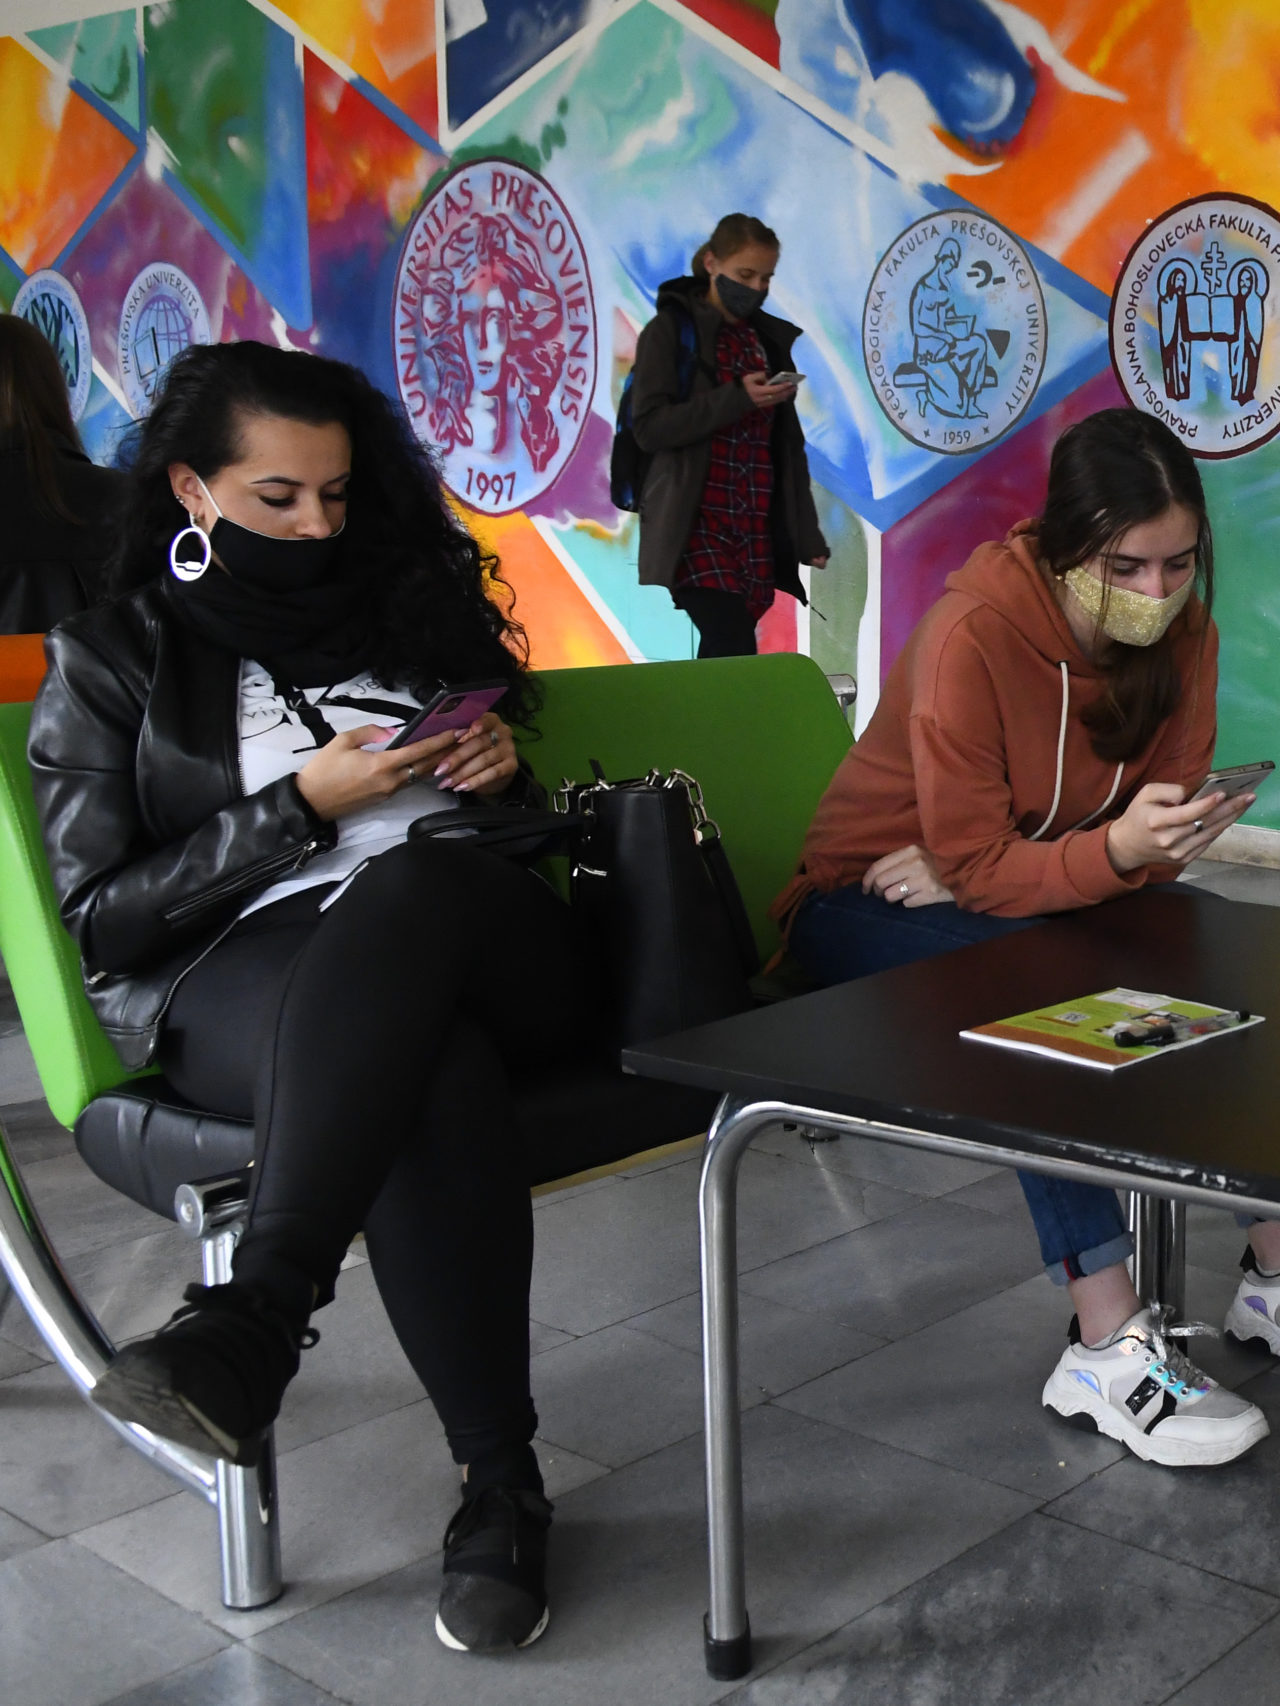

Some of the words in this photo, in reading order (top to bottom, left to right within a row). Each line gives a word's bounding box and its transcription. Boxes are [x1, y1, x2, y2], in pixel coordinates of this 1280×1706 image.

[400, 178, 474, 417] UNIVERSITAS
[491, 171, 589, 423] PRESOVIENSIS
[884, 225, 941, 278] FAKULTA
[951, 219, 1030, 289] PREŠOVSKEJ
[1008, 303, 1040, 415] UNIVERZITY
[1124, 214, 1205, 333] BOHOSLOVECKÁ
[1209, 213, 1272, 249] FAKULTA
[465, 467, 516, 506] 1997
[943, 430, 971, 445] 1959
